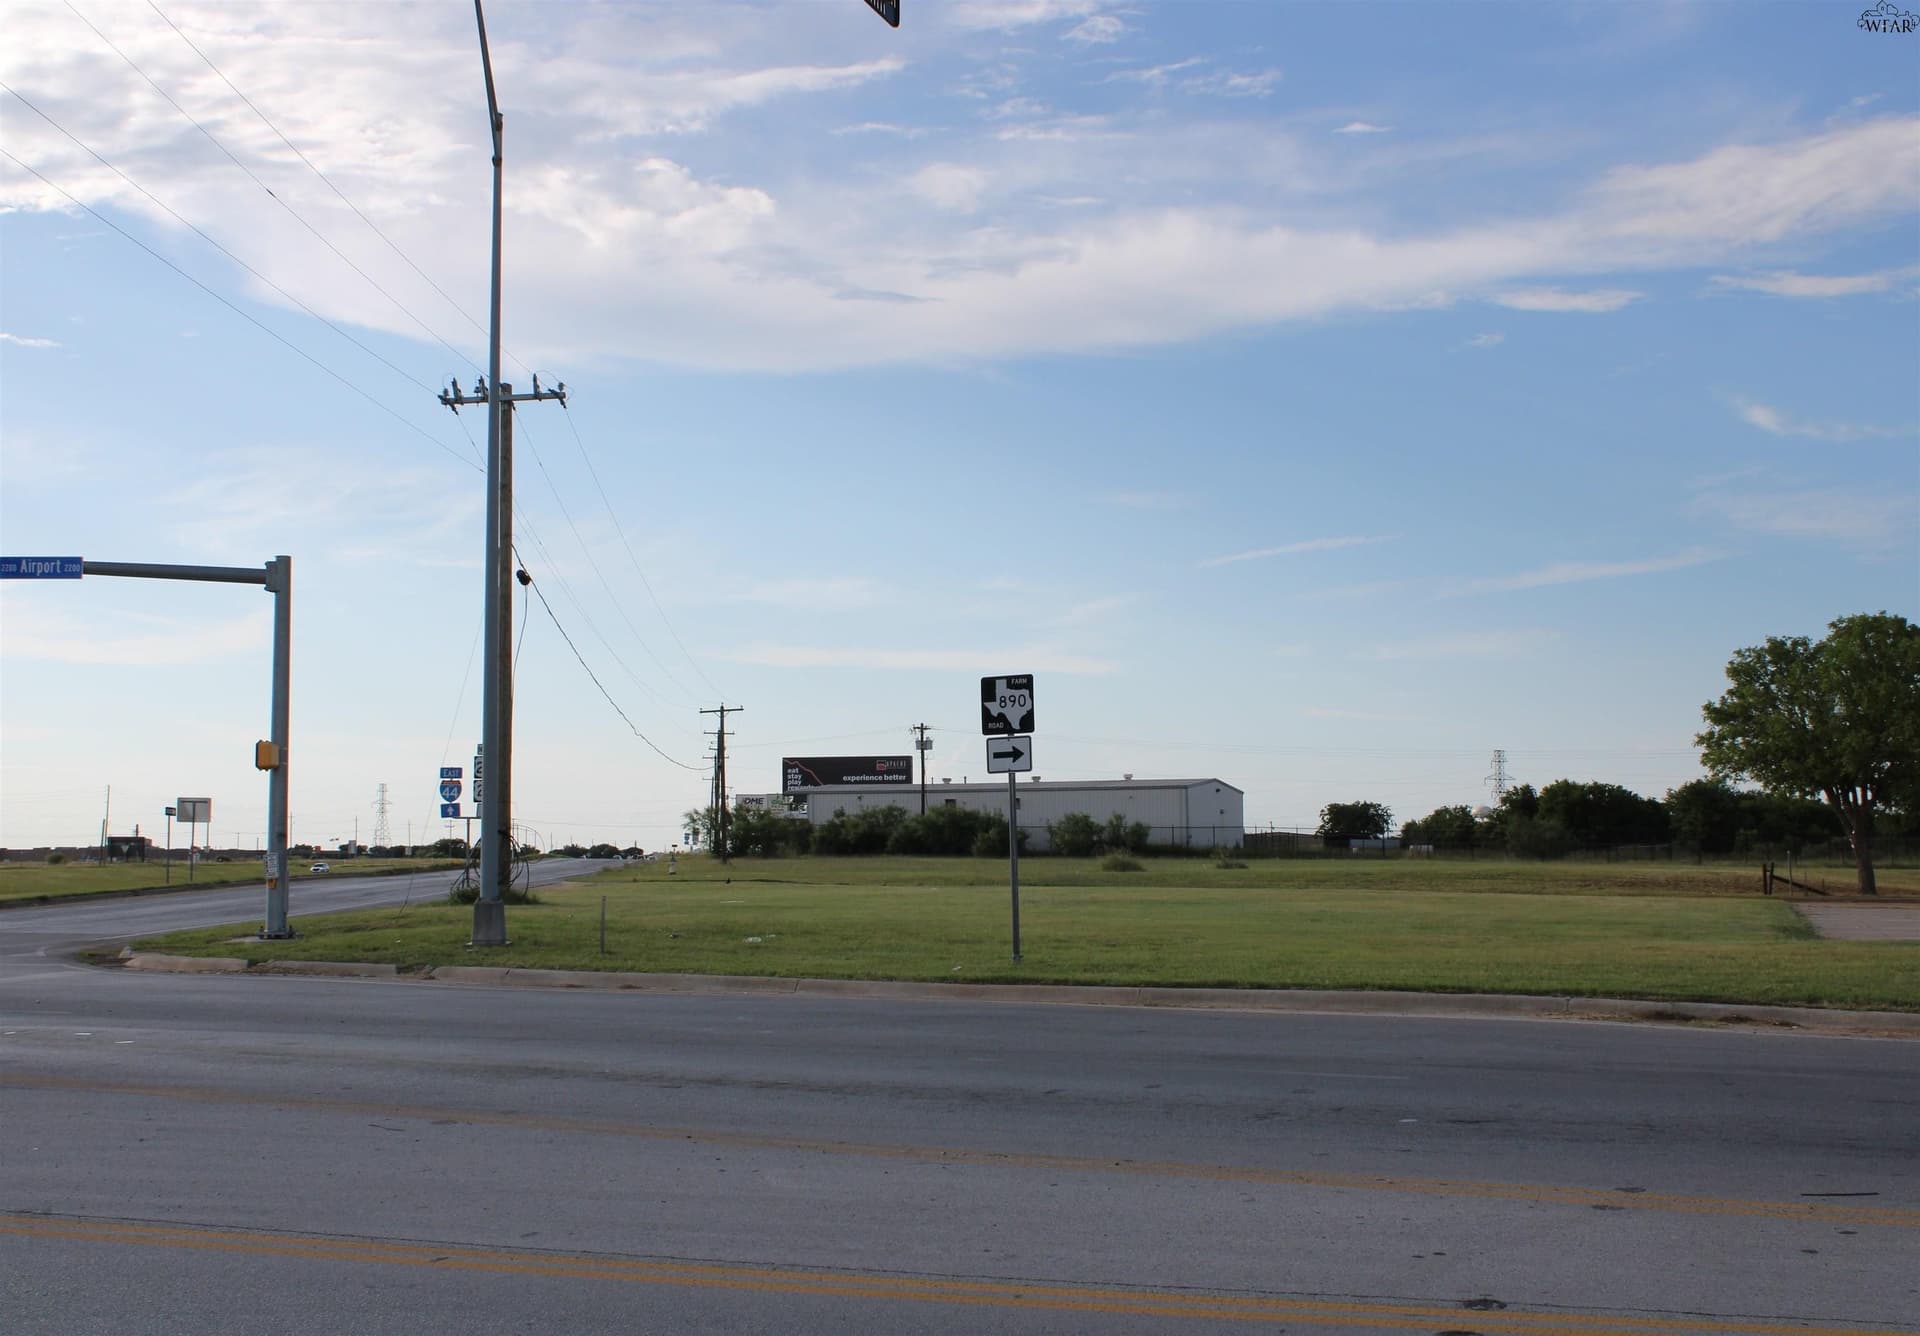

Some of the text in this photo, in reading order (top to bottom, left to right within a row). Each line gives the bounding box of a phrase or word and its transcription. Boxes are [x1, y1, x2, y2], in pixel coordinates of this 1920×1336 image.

[20, 559, 61, 576] Airport
[64, 563, 81, 572] 2200
[999, 694, 1027, 709] 890
[443, 769, 460, 778] EAST
[842, 774, 882, 782] experience
[442, 786, 459, 798] 44
